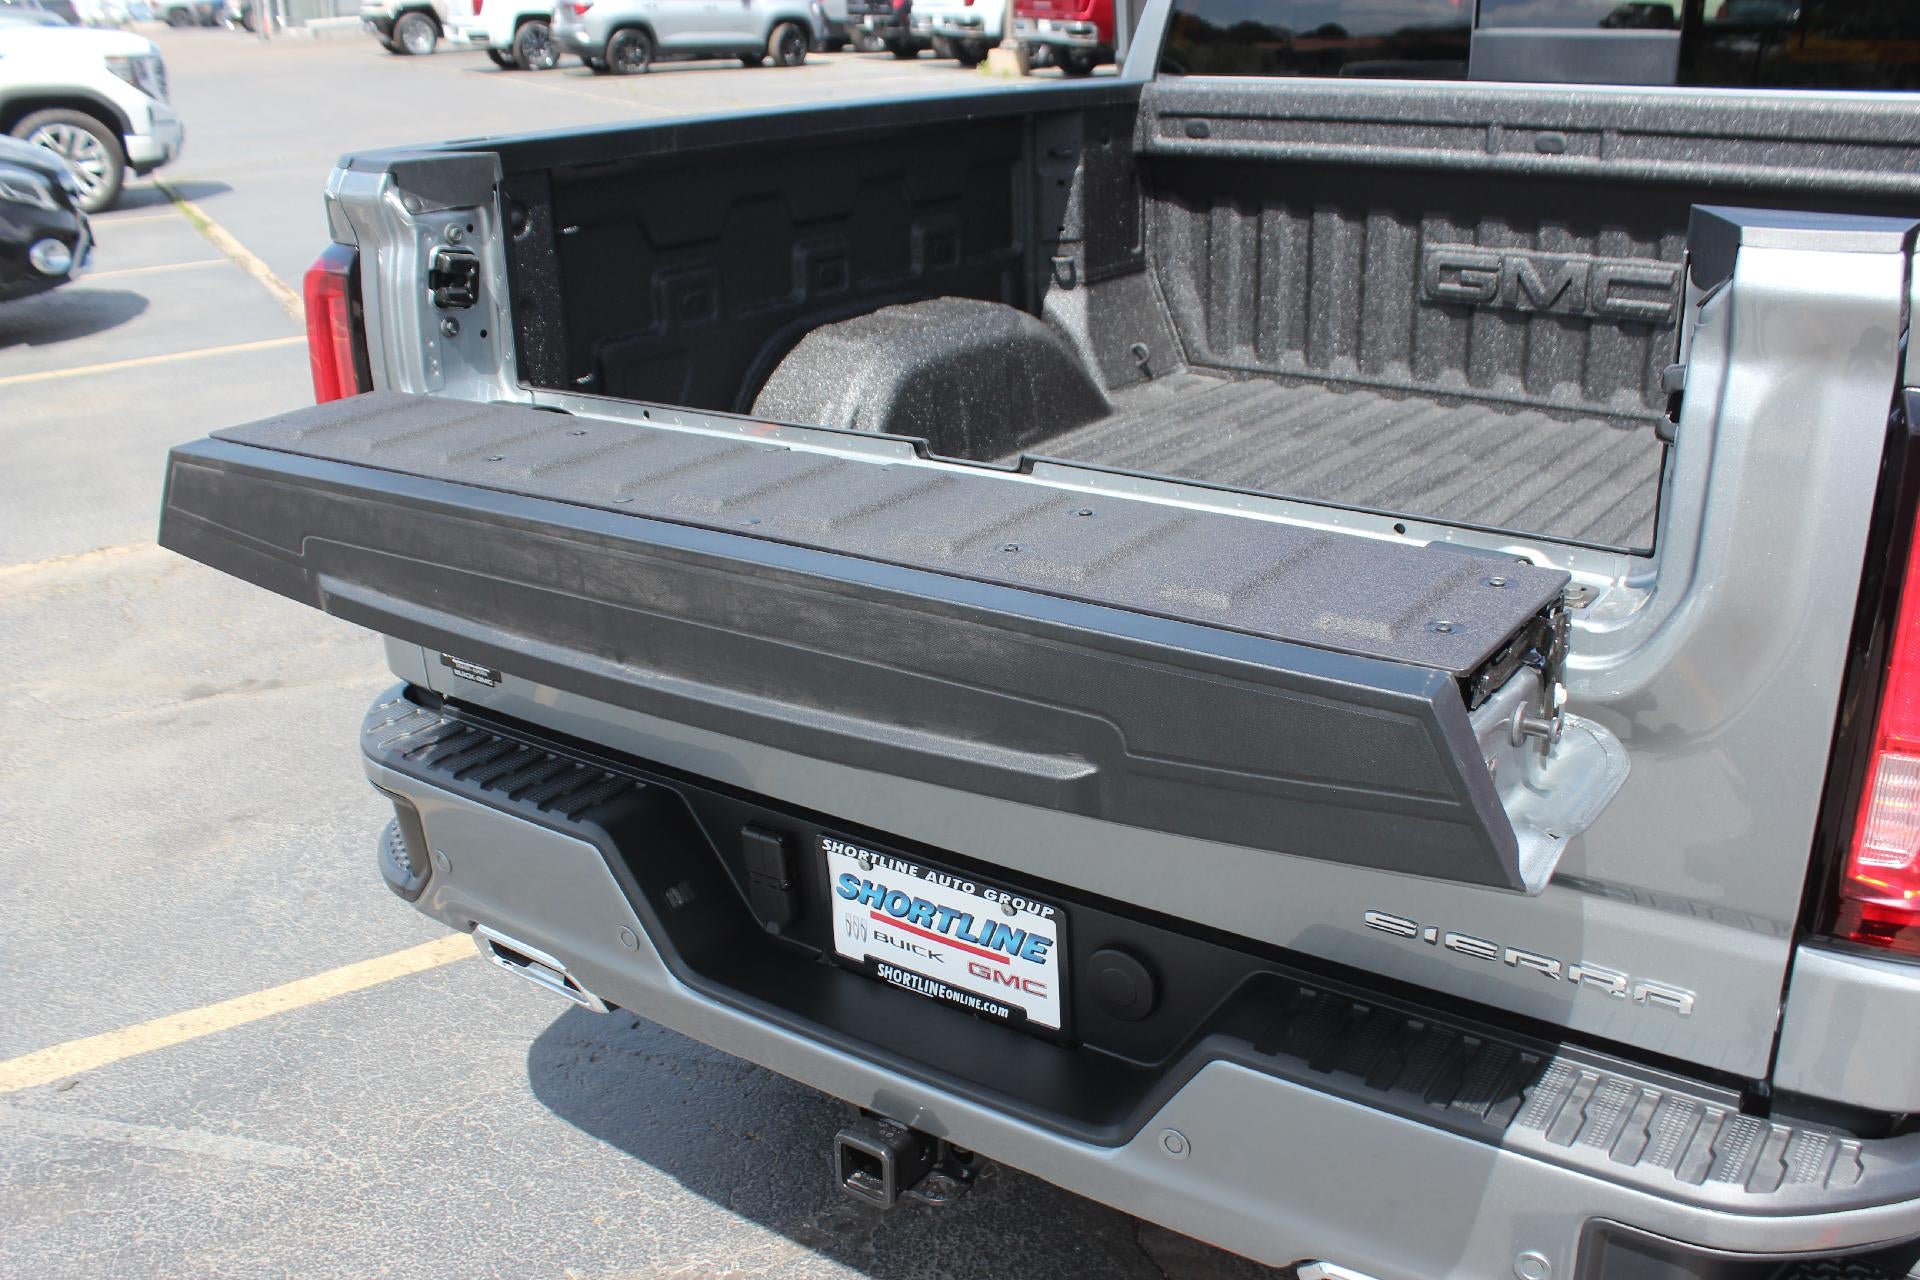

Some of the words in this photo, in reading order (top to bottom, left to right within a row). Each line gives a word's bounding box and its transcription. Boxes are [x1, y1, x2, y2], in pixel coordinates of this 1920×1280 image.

[1425, 250, 1682, 322] GMC
[821, 839, 919, 877] SHORTLINE
[925, 870, 976, 894] AUTO
[983, 889, 1055, 917] GROUP
[835, 872, 1054, 965] SHORTLINE
[873, 930, 945, 964] BUICK
[877, 963, 1009, 1019] SHORTLINEONLINE.com
[968, 961, 1048, 999] GMC
[1363, 909, 1697, 1016] SIERRA
